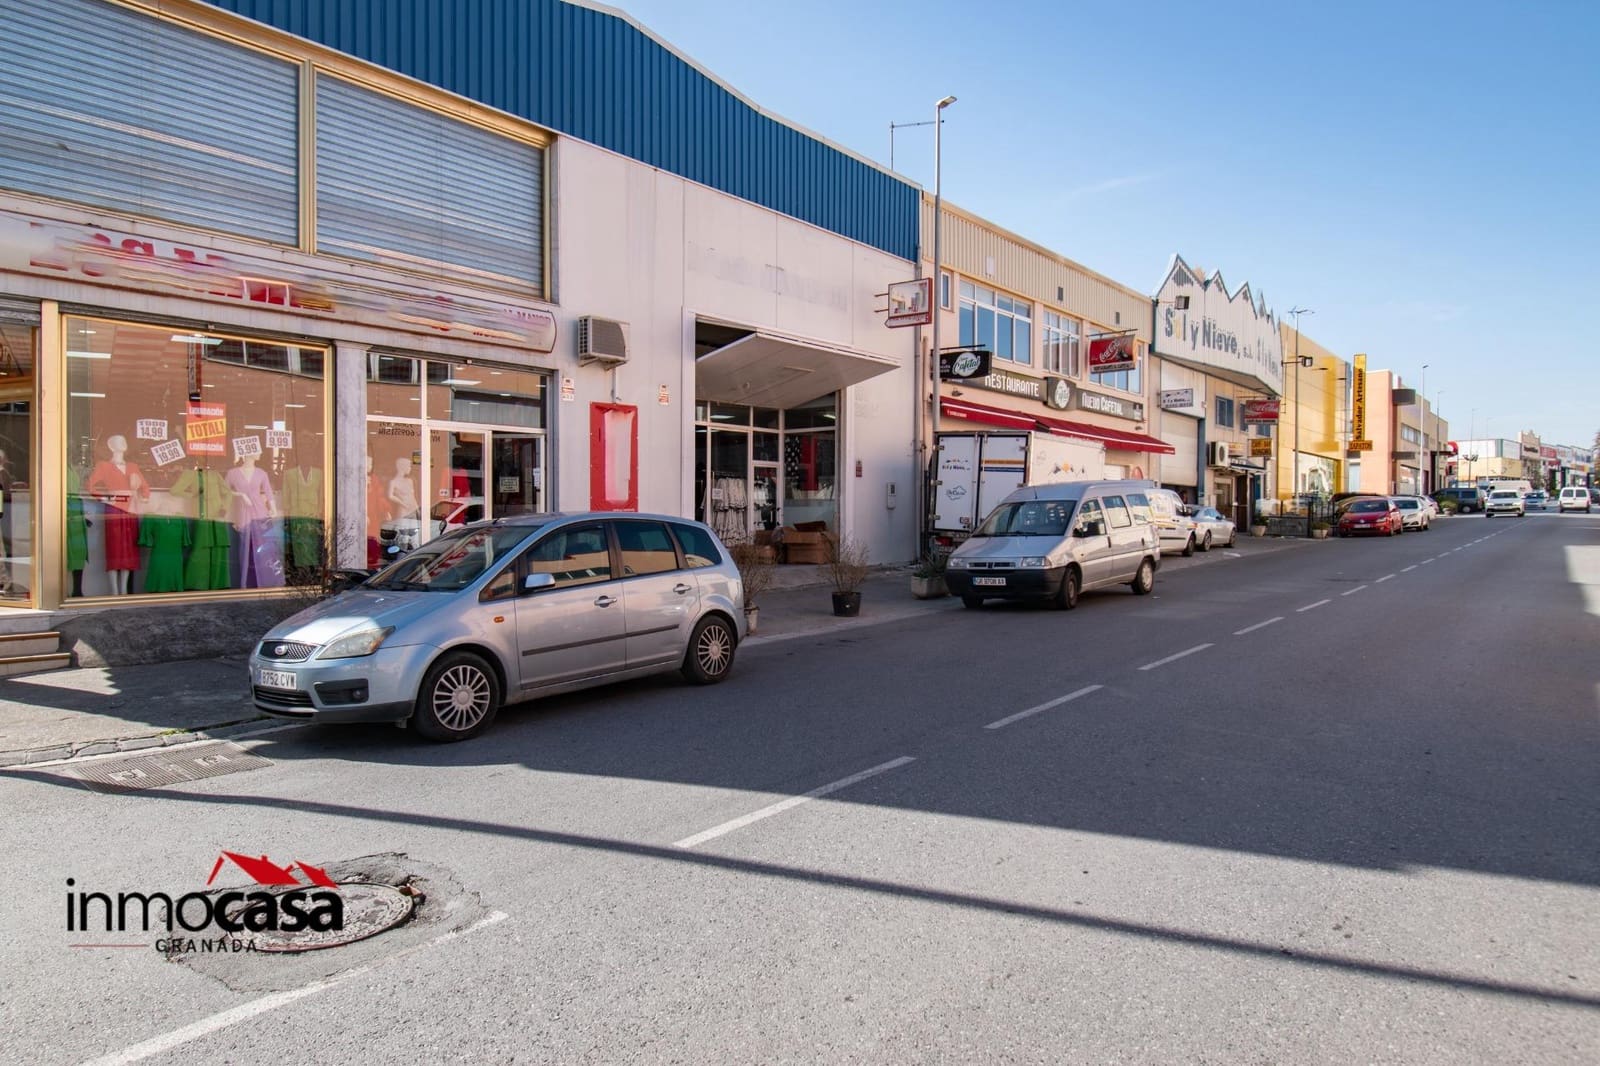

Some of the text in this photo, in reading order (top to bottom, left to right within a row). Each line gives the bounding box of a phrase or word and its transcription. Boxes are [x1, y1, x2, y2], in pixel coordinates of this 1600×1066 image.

[1191, 321, 1200, 351] y
[984, 373, 1040, 398] RESTAURANTE
[188, 420, 225, 438] TOTAL!
